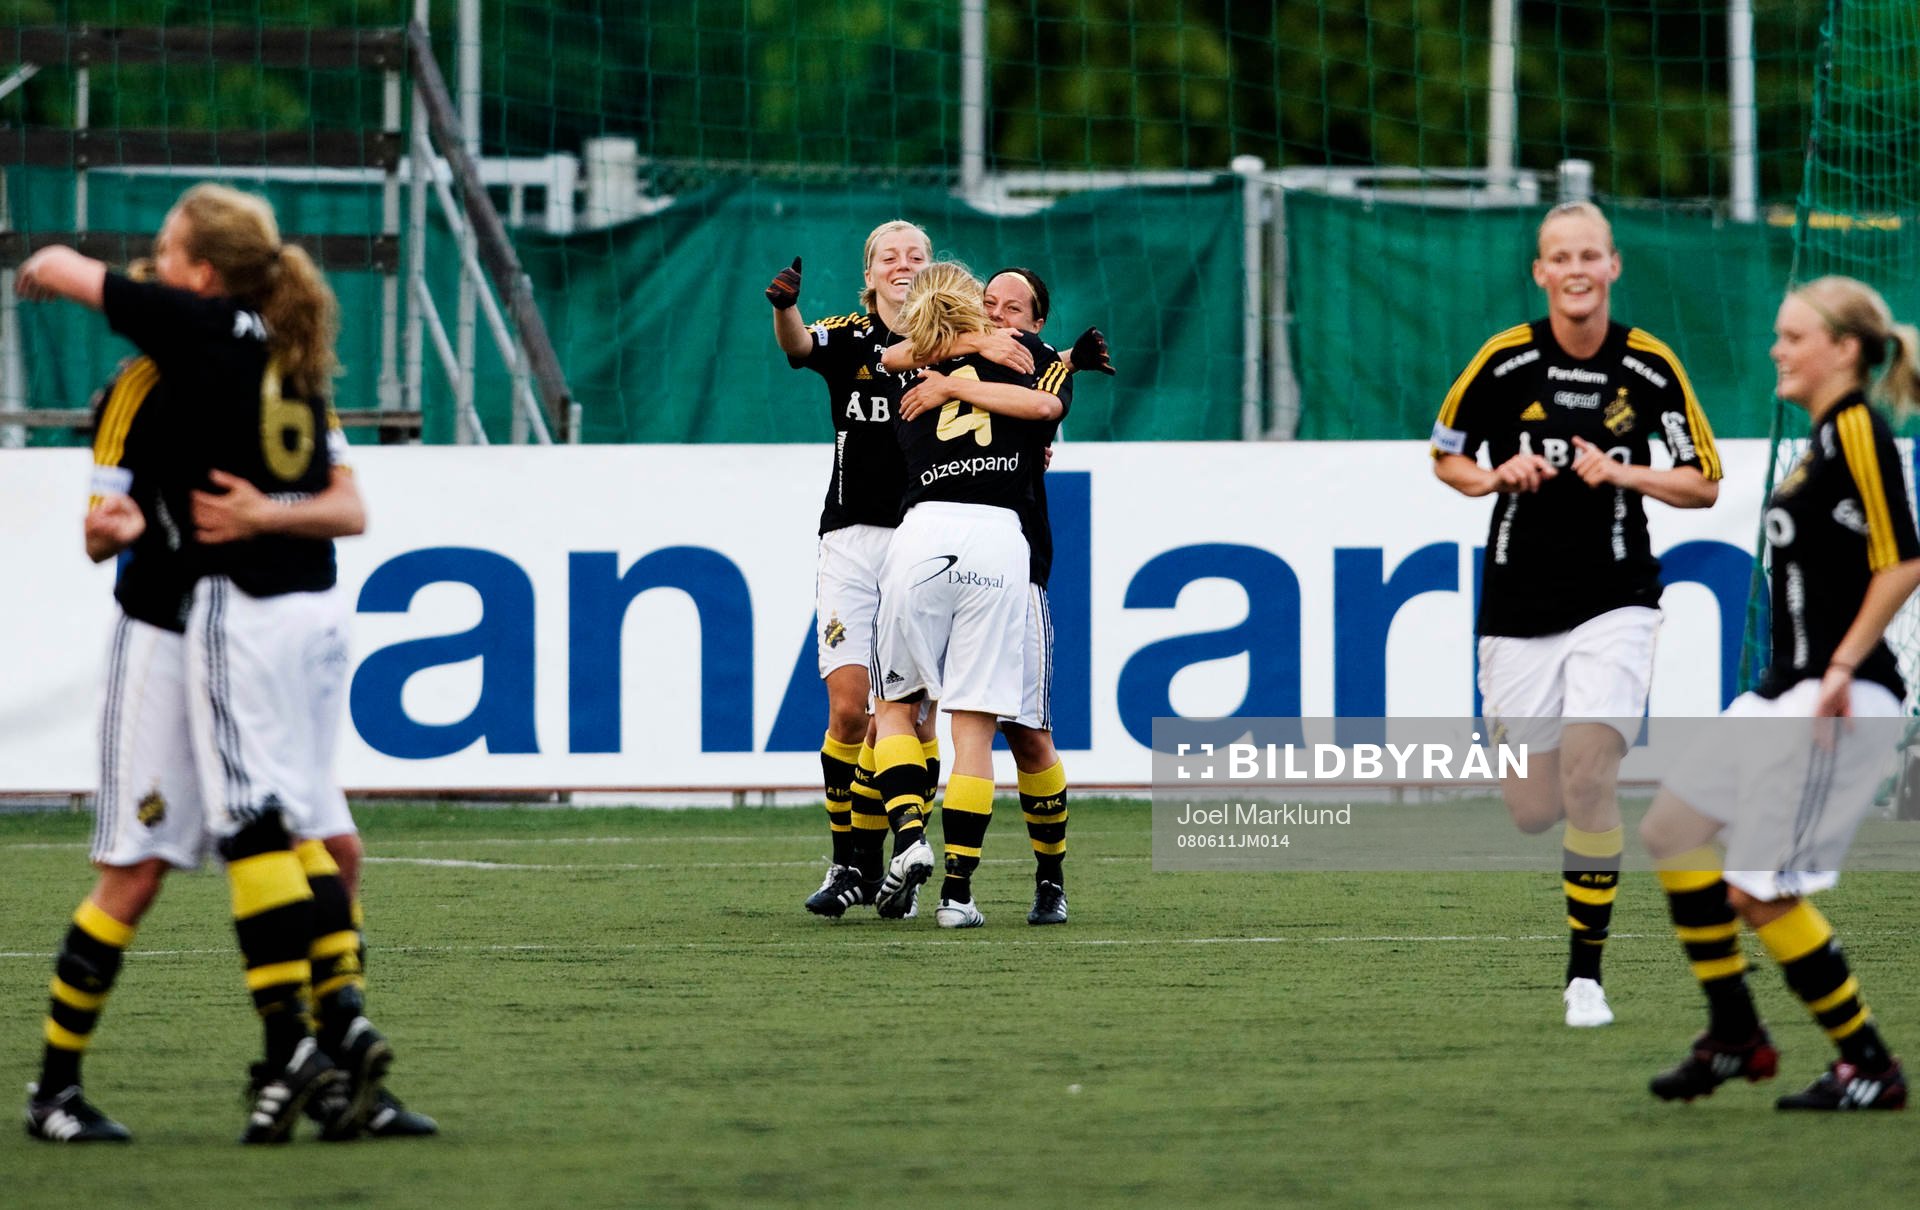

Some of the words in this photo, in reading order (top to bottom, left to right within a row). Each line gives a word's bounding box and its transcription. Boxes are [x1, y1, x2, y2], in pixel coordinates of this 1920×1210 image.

[260, 355, 316, 481] 6
[845, 391, 891, 422] ÅB
[936, 364, 993, 447] 4
[948, 570, 1004, 590] DeRoyal
[117, 469, 1771, 762] anlar
[827, 786, 850, 797] AIK
[1033, 797, 1062, 810] AIK
